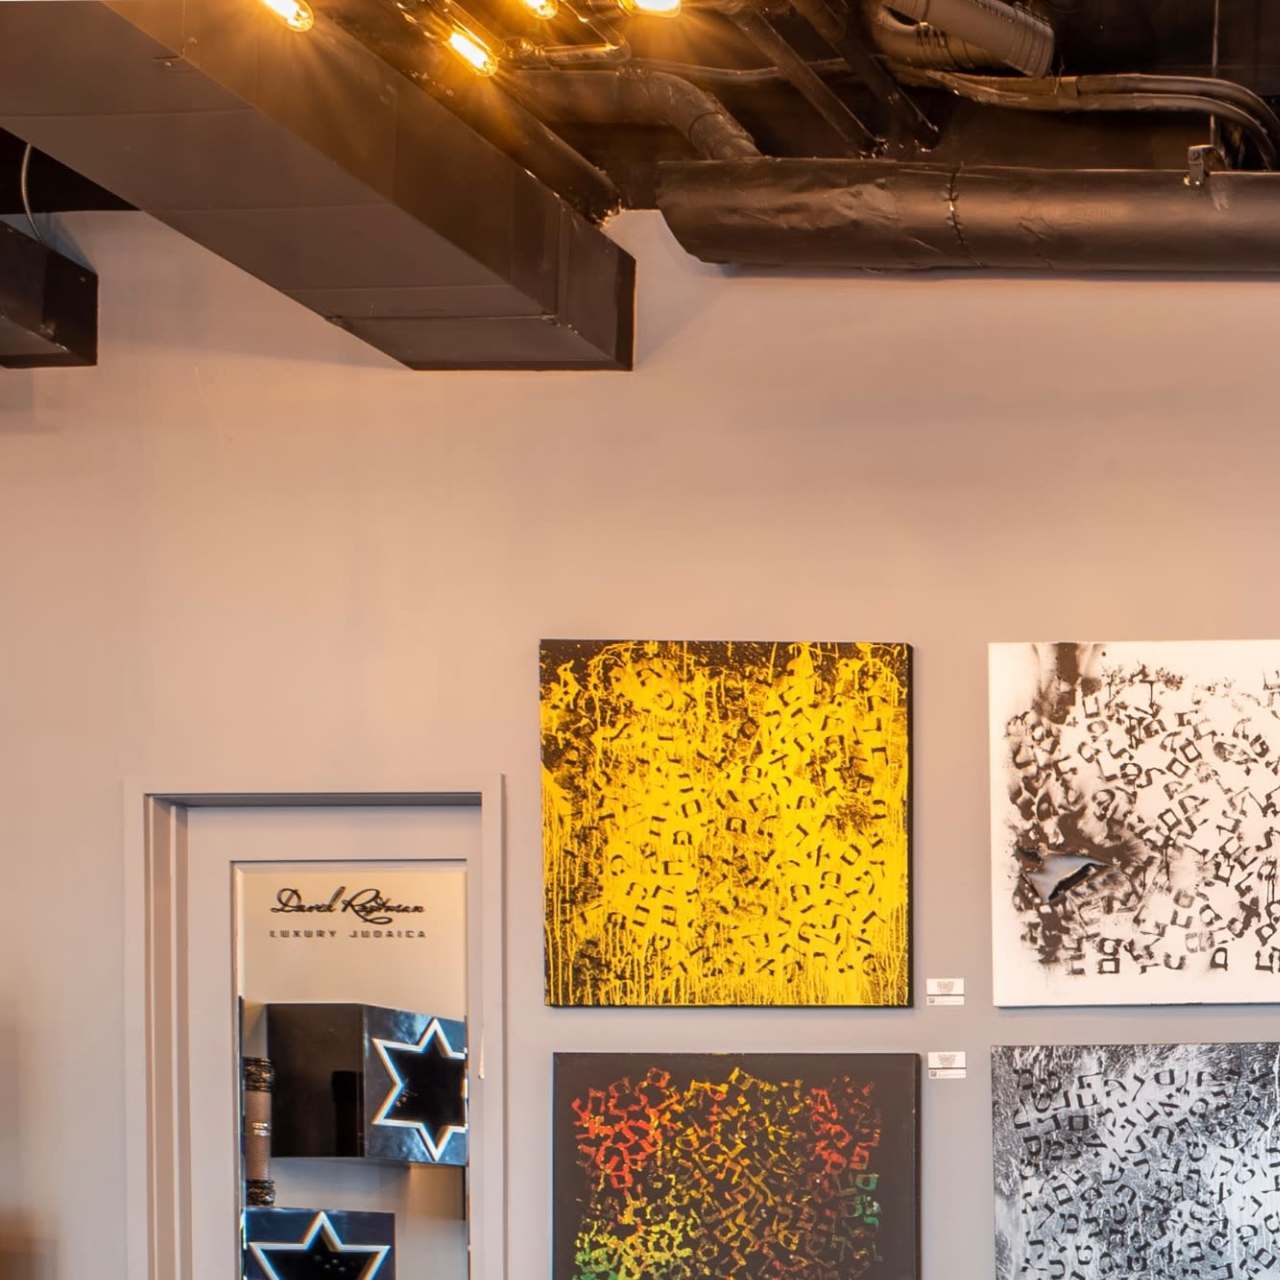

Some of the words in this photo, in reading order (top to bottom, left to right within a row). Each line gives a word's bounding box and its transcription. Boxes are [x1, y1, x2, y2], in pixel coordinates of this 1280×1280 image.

[270, 886, 346, 913] David
[269, 930, 337, 939] LUXURY
[349, 930, 427, 939] JUDAICA
